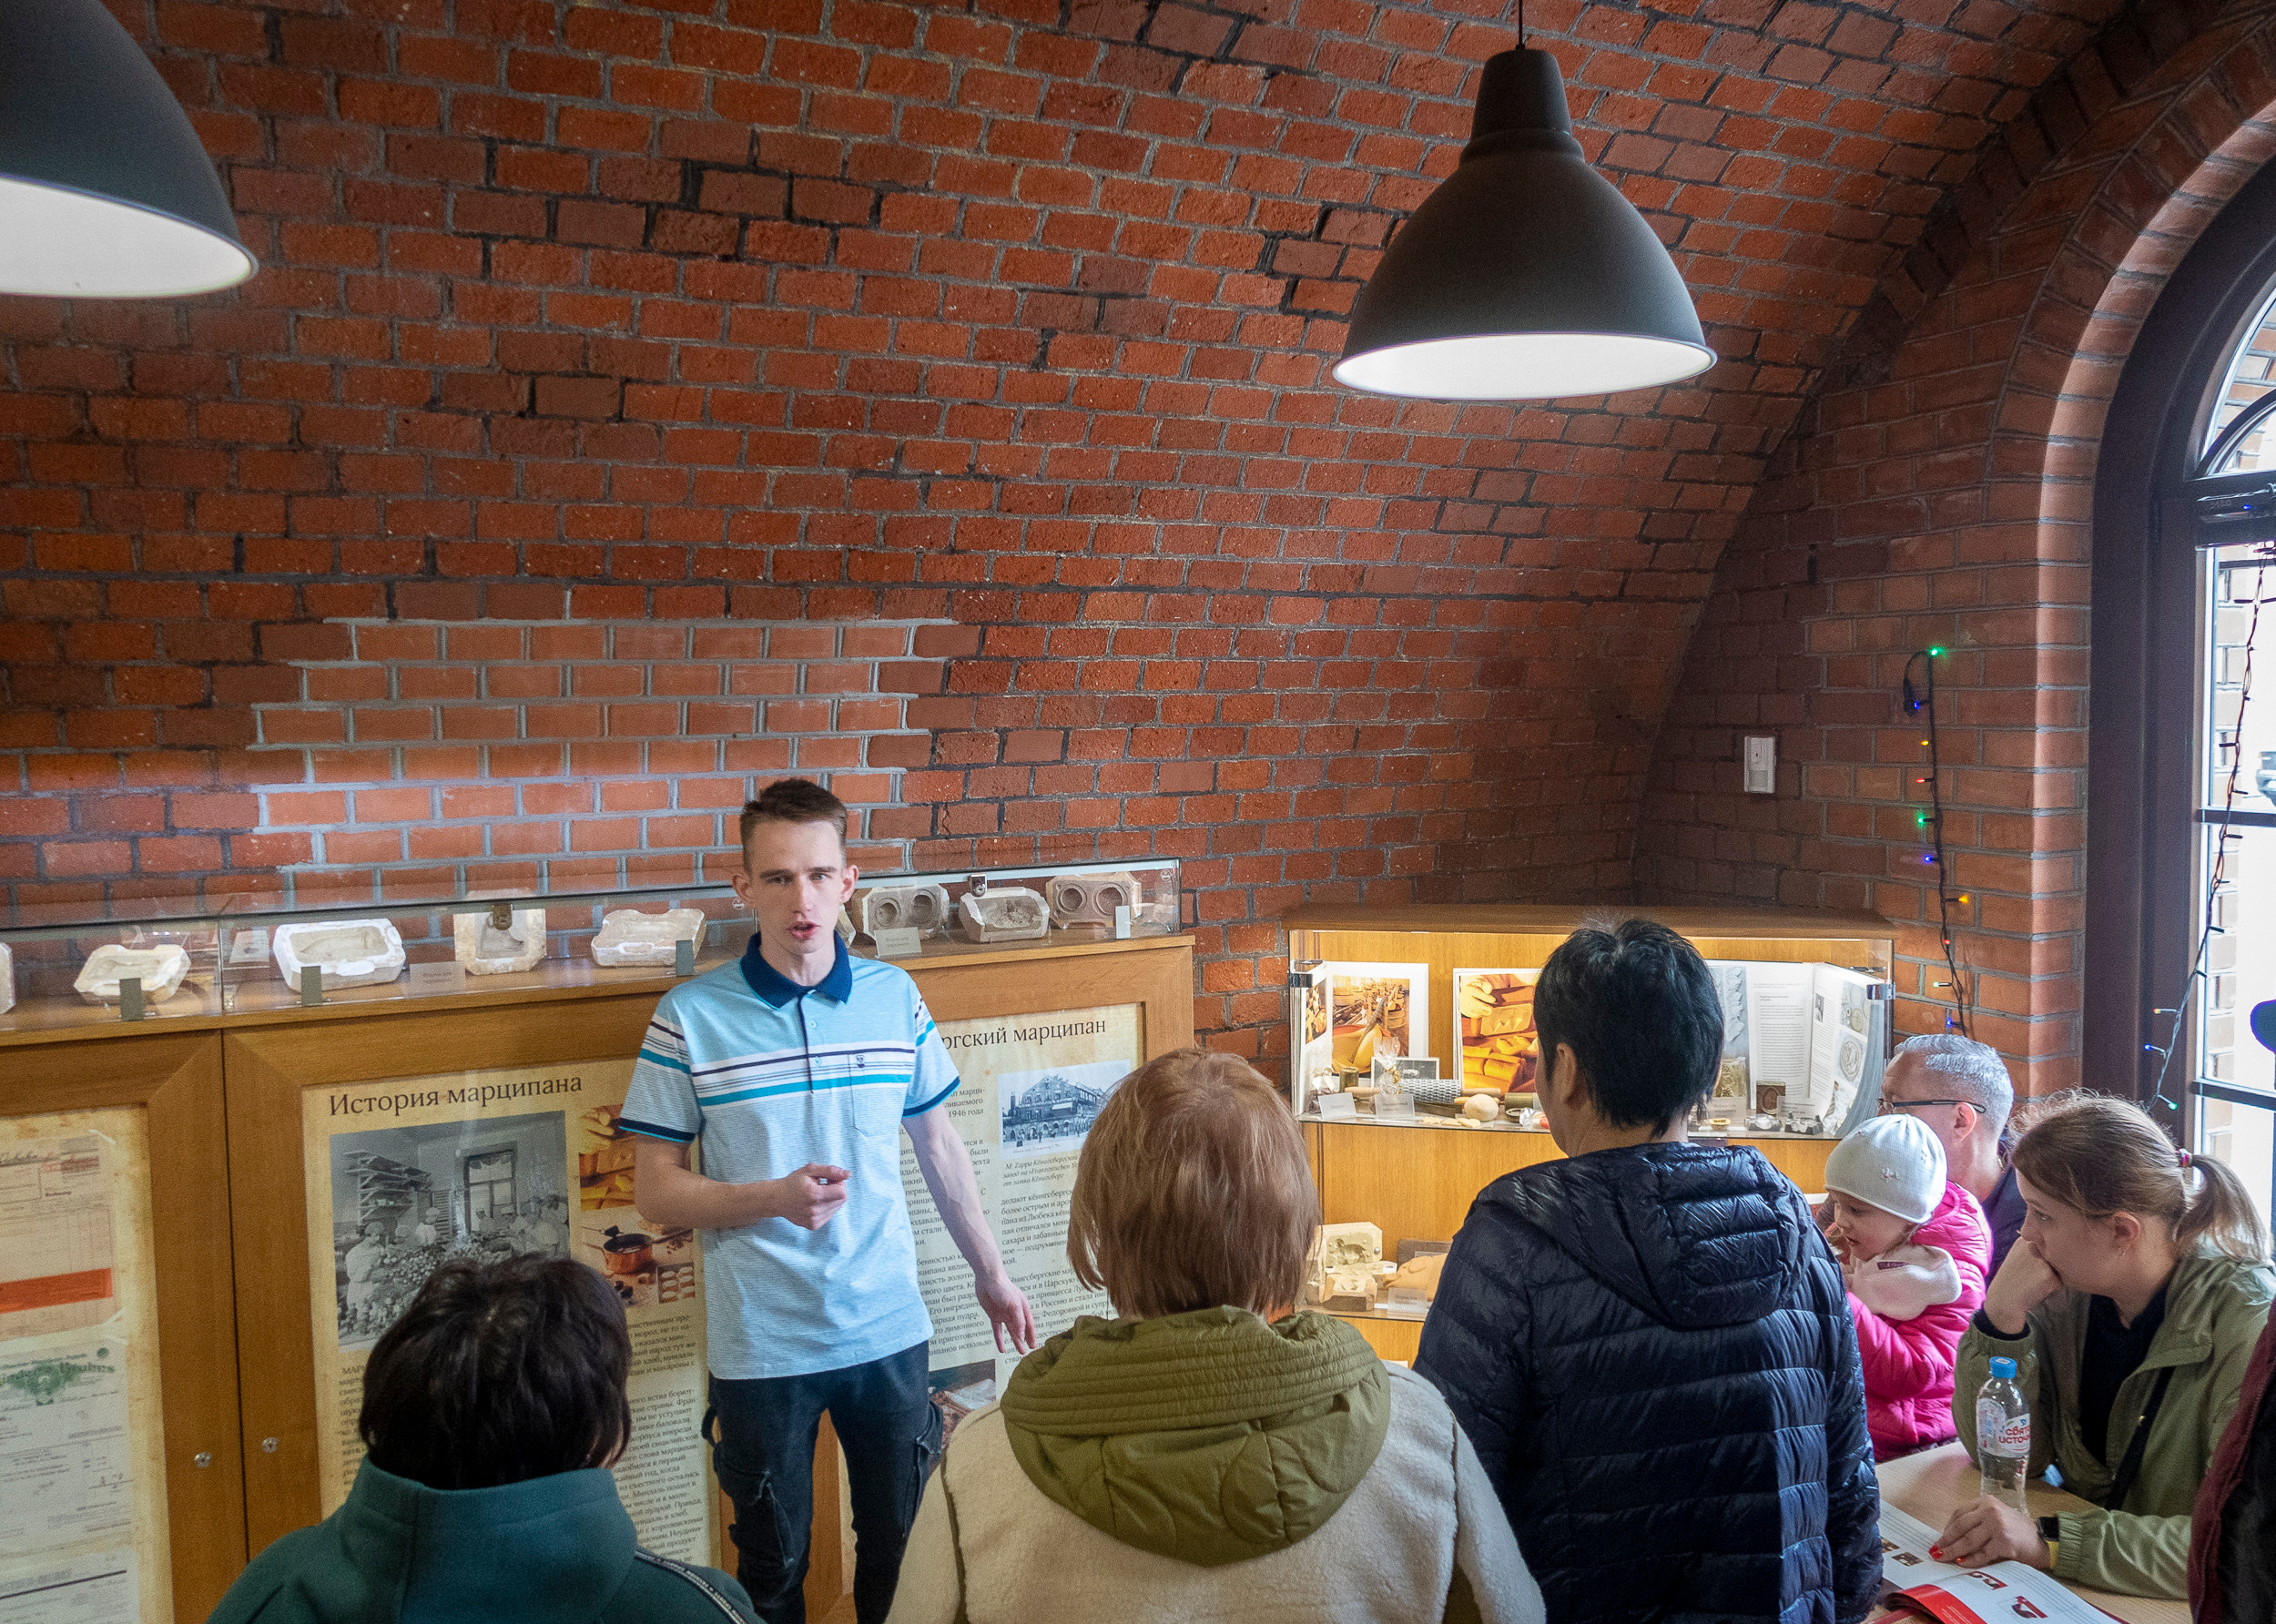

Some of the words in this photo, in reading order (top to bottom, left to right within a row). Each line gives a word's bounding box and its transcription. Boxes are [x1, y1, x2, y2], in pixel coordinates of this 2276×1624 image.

[941, 1028, 1007, 1051] ргский
[1013, 1020, 1106, 1045] марципан
[330, 1091, 439, 1117] История
[447, 1076, 582, 1108] марципана
[944, 1099, 983, 1108] ливаемого
[949, 1109, 965, 1117] 1946
[905, 1187, 929, 1196] первы
[1001, 1196, 1025, 1206] делают
[1001, 1207, 1021, 1215] более
[1022, 1203, 1049, 1212] острым
[1027, 1212, 1054, 1221] Любека
[1015, 1222, 1051, 1233] отличался
[1001, 1236, 1025, 1245] сахара
[917, 1254, 955, 1265] бенностью
[1040, 1298, 1066, 1308] Россию
[930, 1306, 941, 1315] Его
[2006, 1425, 2030, 1436] СВЯТ
[1998, 1435, 2030, 1444] ИСТОЧ
